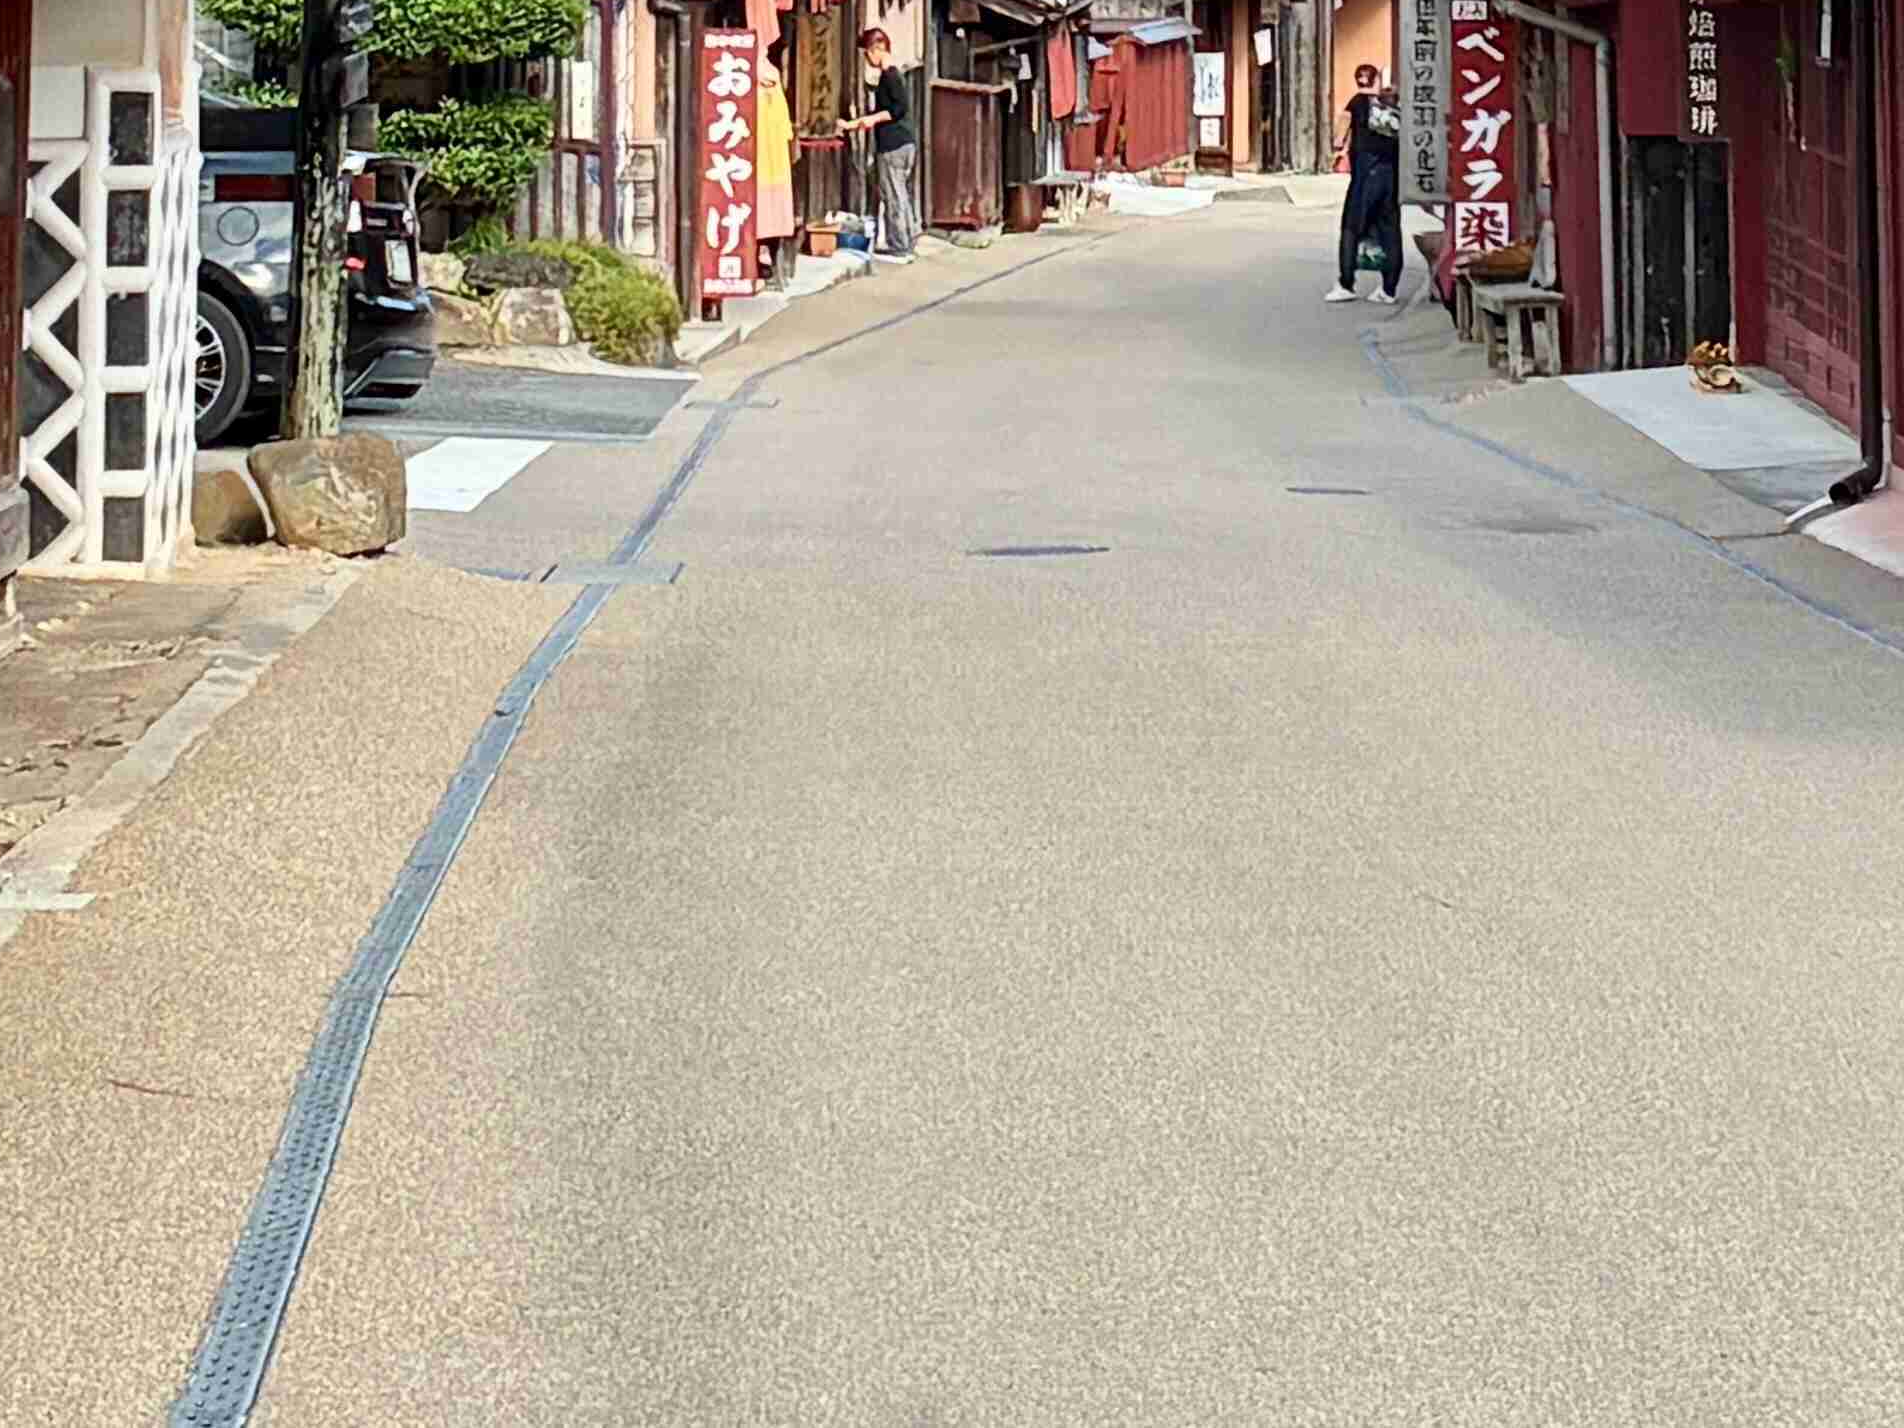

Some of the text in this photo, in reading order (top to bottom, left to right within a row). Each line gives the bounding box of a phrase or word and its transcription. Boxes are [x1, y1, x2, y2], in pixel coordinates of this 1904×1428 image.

[704, 50, 753, 256] おみやげ
[1456, 26, 1512, 251] ベンガラ染
